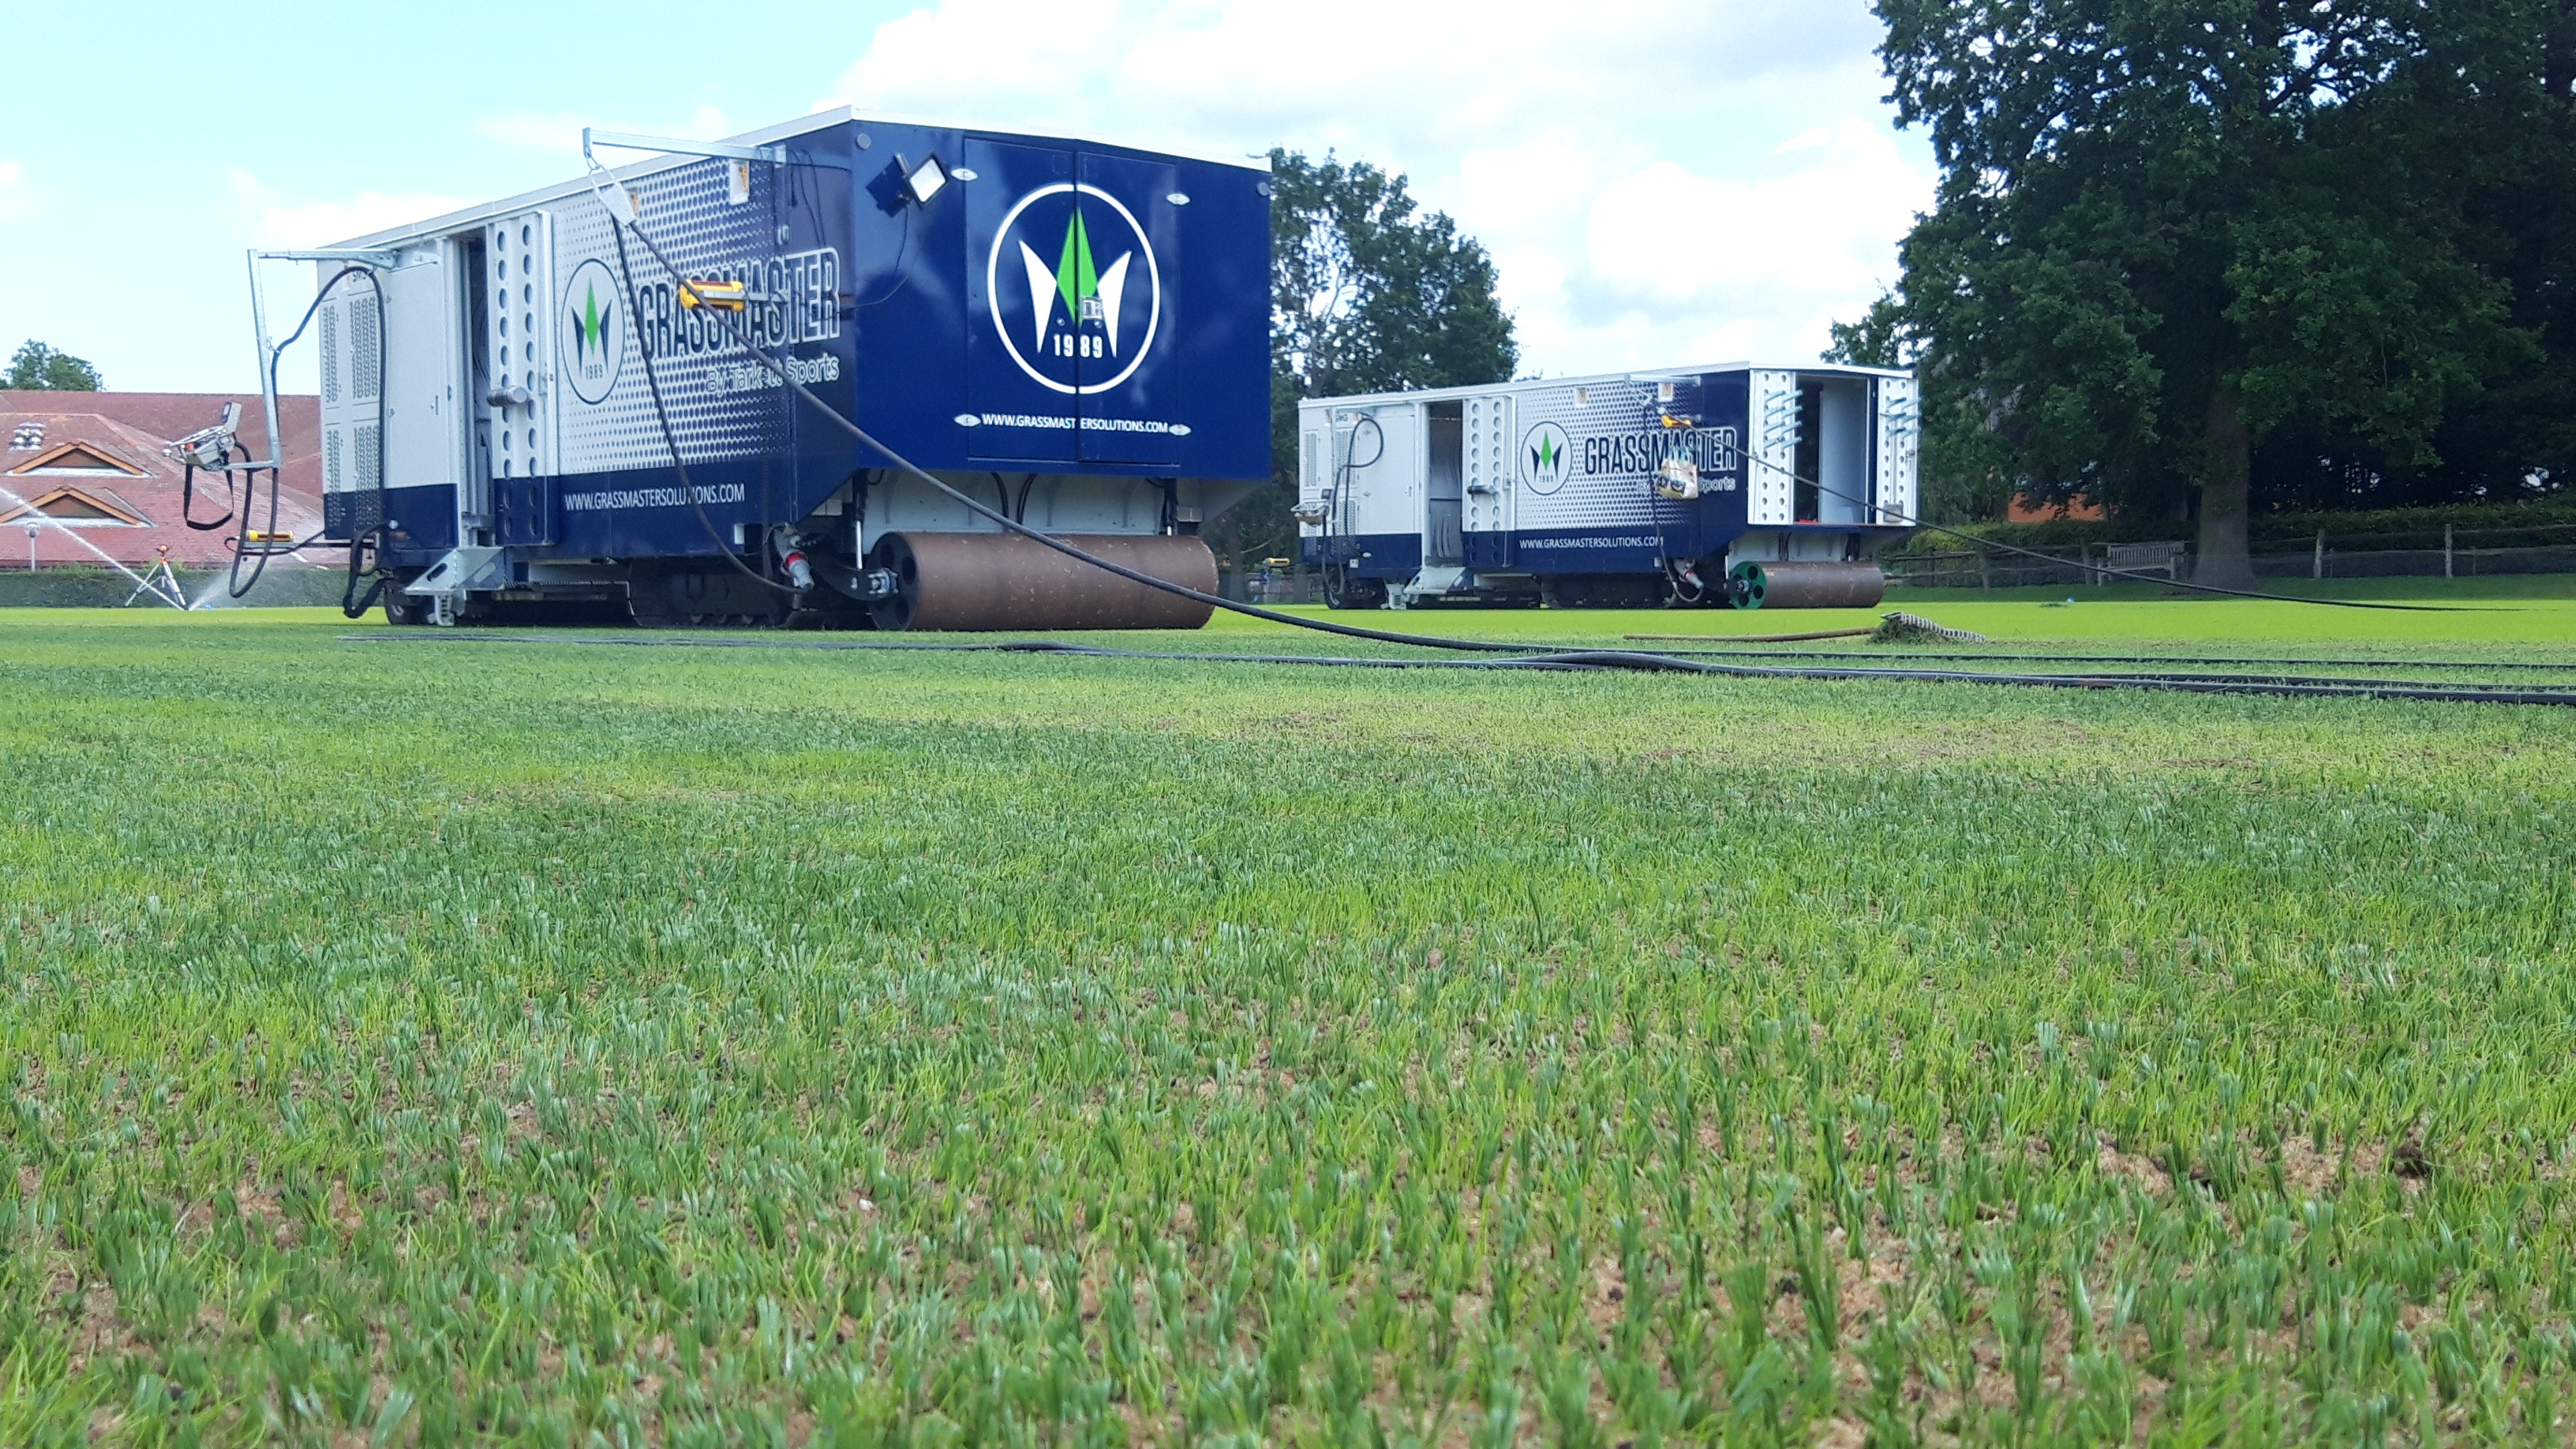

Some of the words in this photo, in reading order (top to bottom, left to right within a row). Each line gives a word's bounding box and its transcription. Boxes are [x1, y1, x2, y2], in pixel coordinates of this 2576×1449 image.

[1053, 333, 1103, 358] 1989
[585, 364, 603, 380] 1989
[786, 352, 840, 385] Sports
[981, 413, 1168, 432] WWW.GRASSMASTERSOLUTIONS.COM
[1697, 475, 1736, 494] Sports
[1519, 536, 1664, 549] WWW.GRASSMASTERSOLUTIONS.COM
